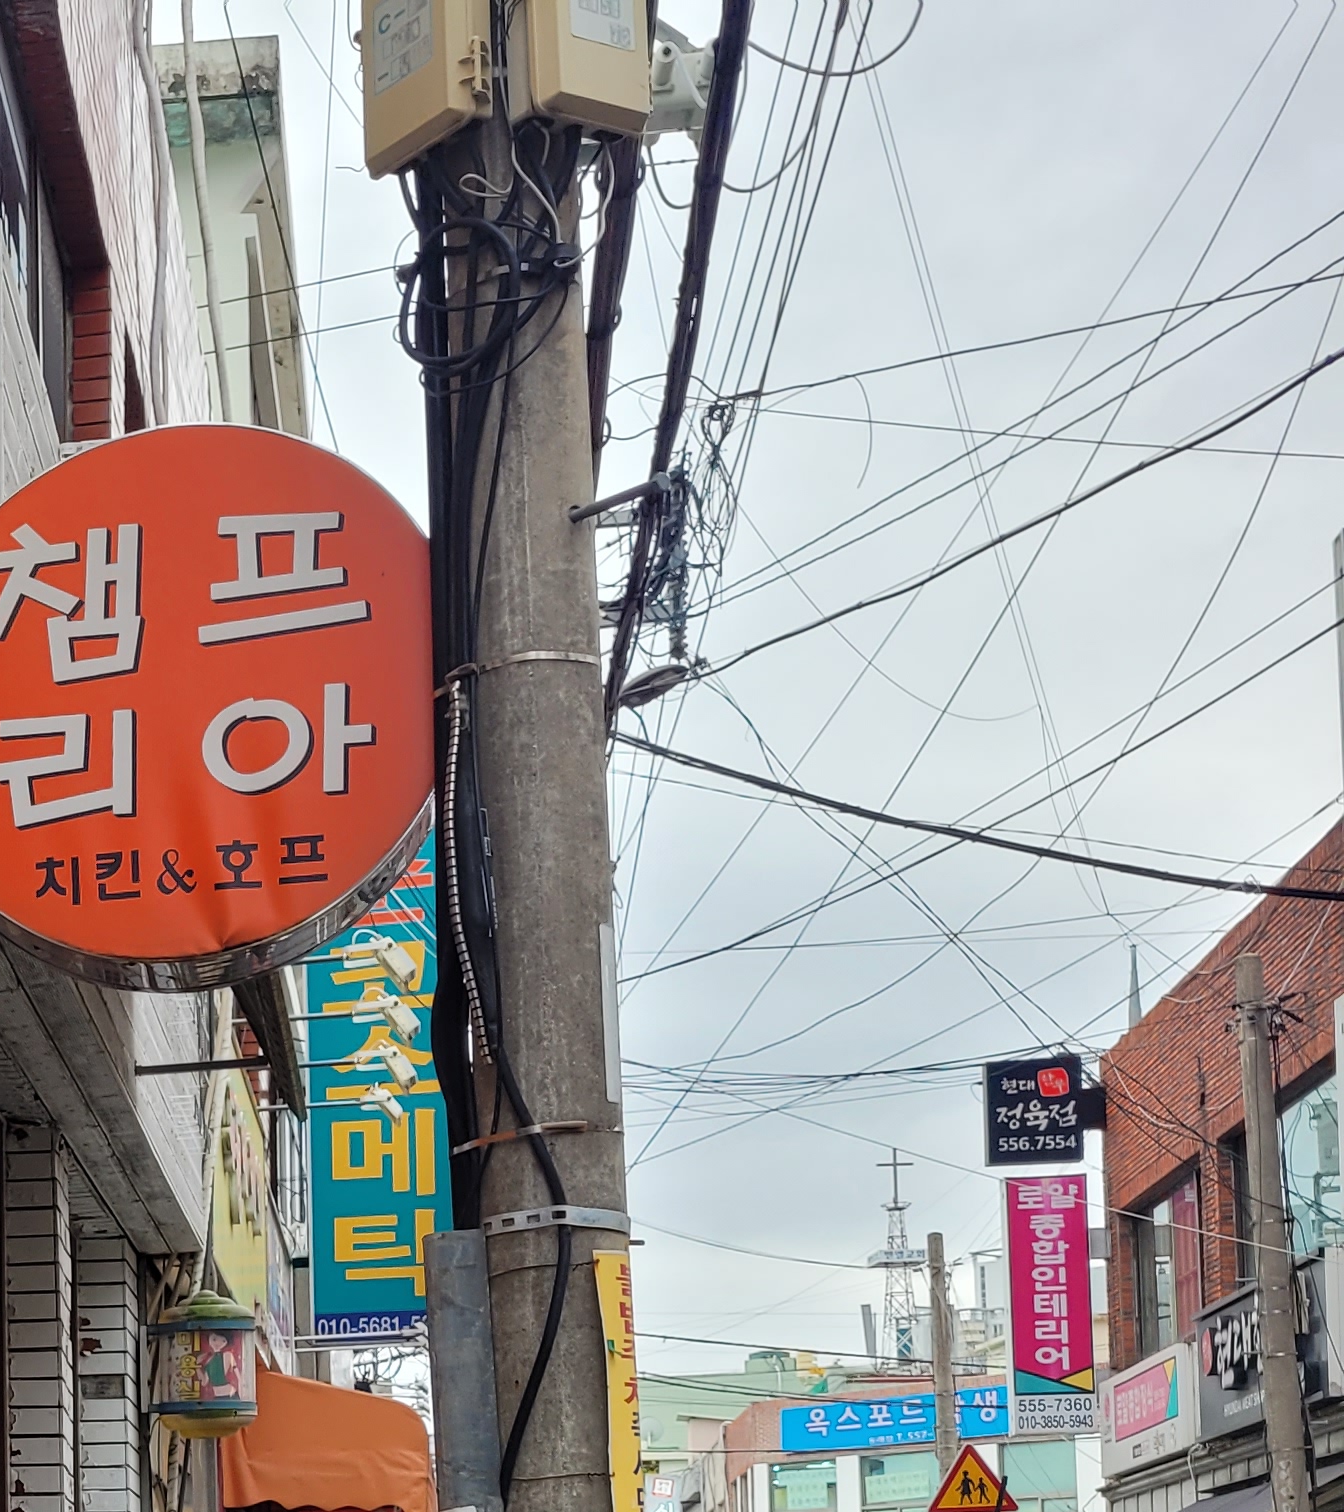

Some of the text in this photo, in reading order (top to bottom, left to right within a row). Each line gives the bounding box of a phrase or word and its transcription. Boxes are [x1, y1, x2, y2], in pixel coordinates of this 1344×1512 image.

[1000, 1076, 1036, 1095] 현대
[995, 1098, 1079, 1132] 정육점
[997, 1133, 1078, 1153] 556.7554
[1028, 1214, 1074, 1373] 종합인테리어
[1017, 1396, 1093, 1414] 555-7360
[804, 1398, 928, 1438] 옥스포드
[1017, 1412, 1095, 1431] 010-3850-5943
